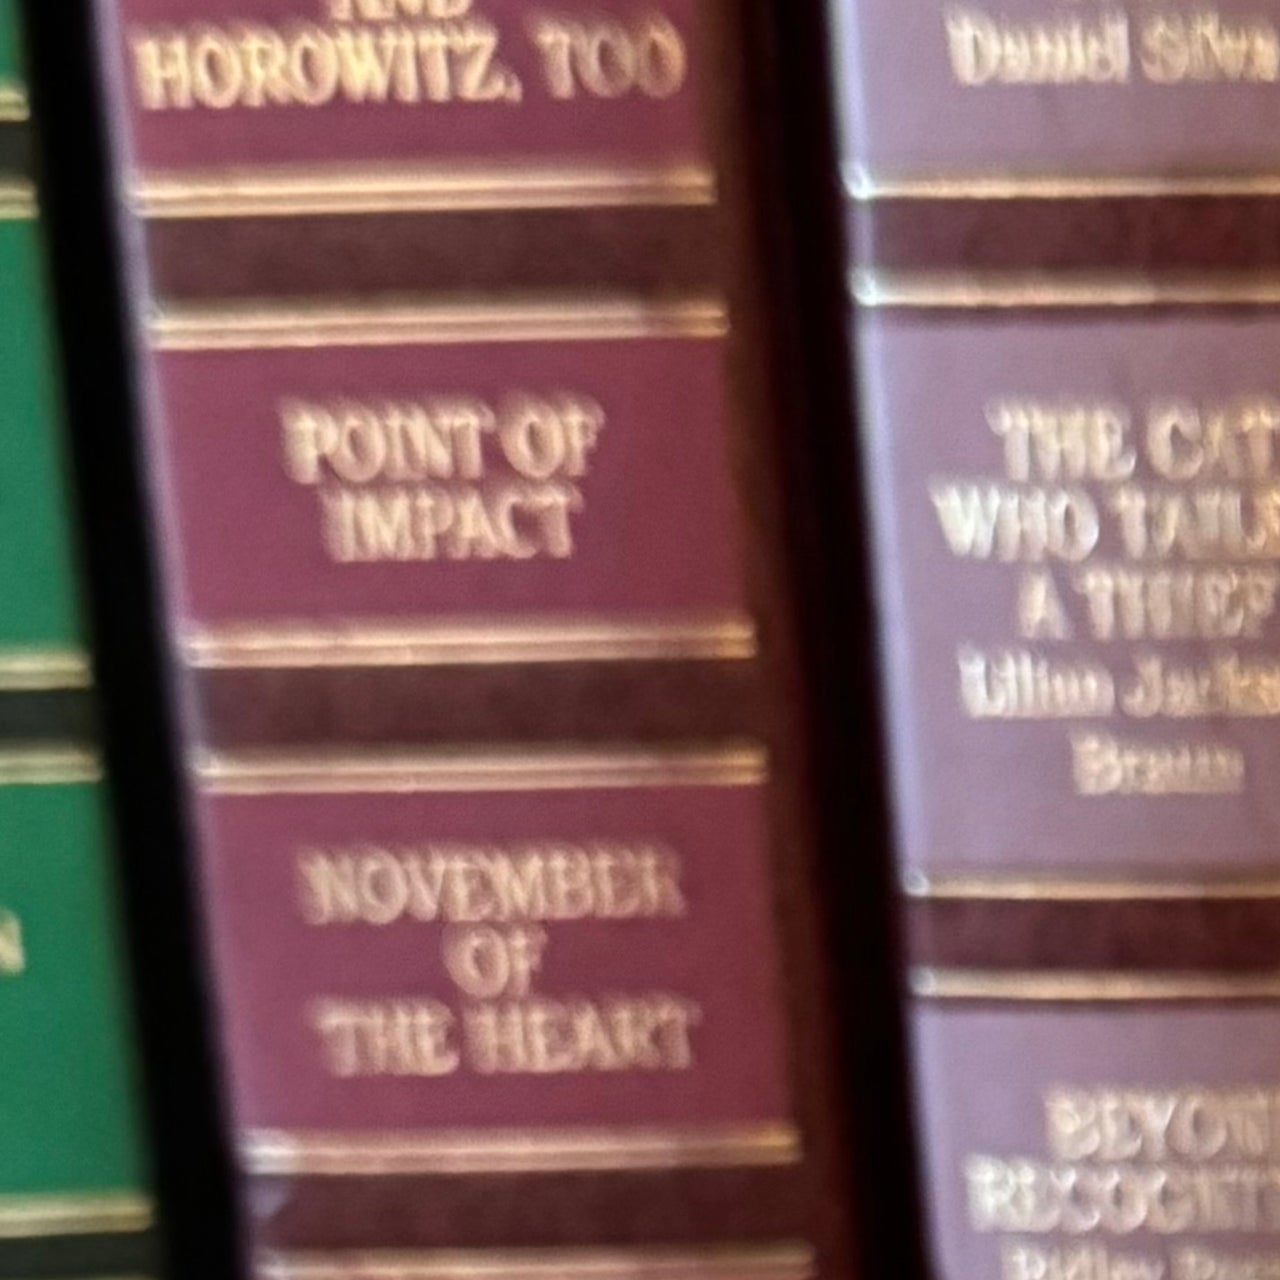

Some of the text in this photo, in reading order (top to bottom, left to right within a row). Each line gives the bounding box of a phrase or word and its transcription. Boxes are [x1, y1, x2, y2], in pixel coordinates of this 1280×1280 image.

[530, 14, 688, 98] TOO
[280, 395, 605, 484] POINT OF
[986, 400, 1136, 482] THE
[320, 484, 584, 562] IMPACT
[930, 475, 1100, 562] WHO
[1017, 568, 1070, 640] A
[298, 842, 688, 925] NOVEMBER
[441, 922, 550, 1000] OF
[310, 994, 698, 1078] THE HEART
